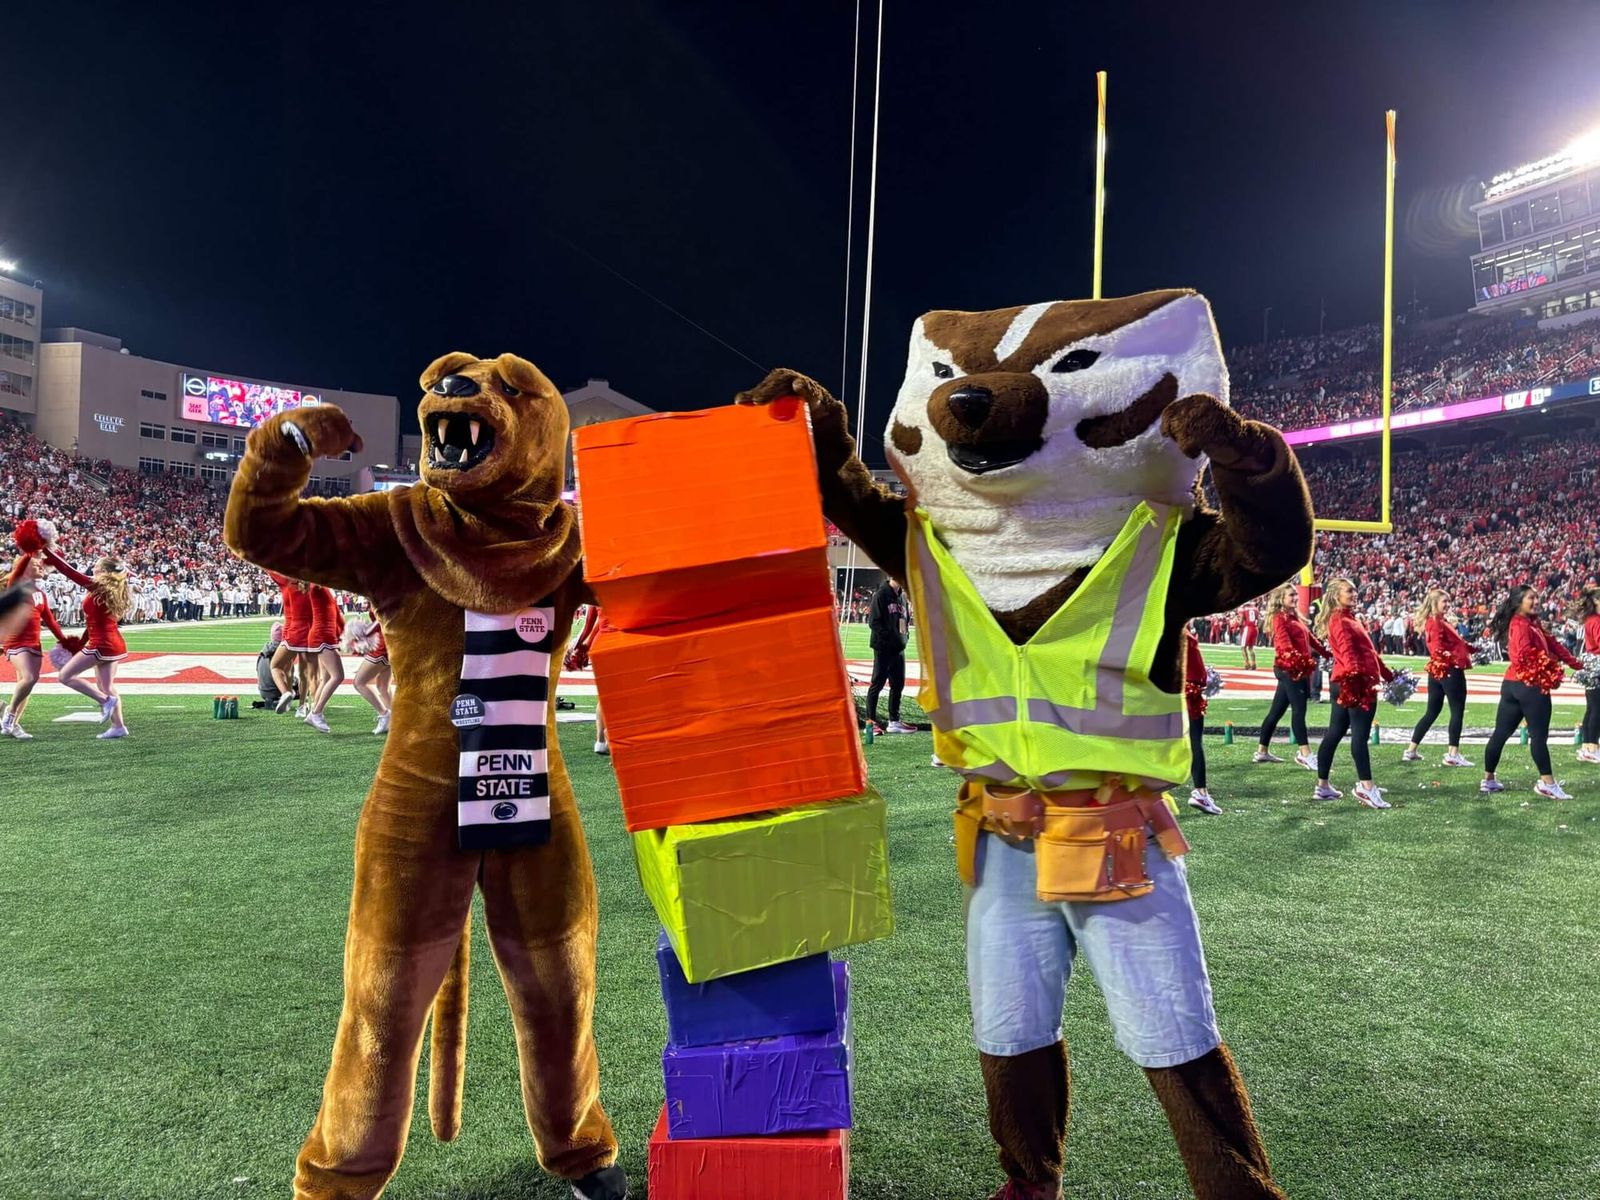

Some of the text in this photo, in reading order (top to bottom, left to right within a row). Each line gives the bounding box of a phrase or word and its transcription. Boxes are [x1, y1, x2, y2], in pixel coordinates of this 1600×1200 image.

[520, 617, 543, 625] PENN
[519, 625, 545, 633] STATE
[456, 699, 476, 708] PENN
[455, 706, 479, 716] STATE
[477, 754, 532, 772] PENN
[476, 779, 531, 797] STATE
